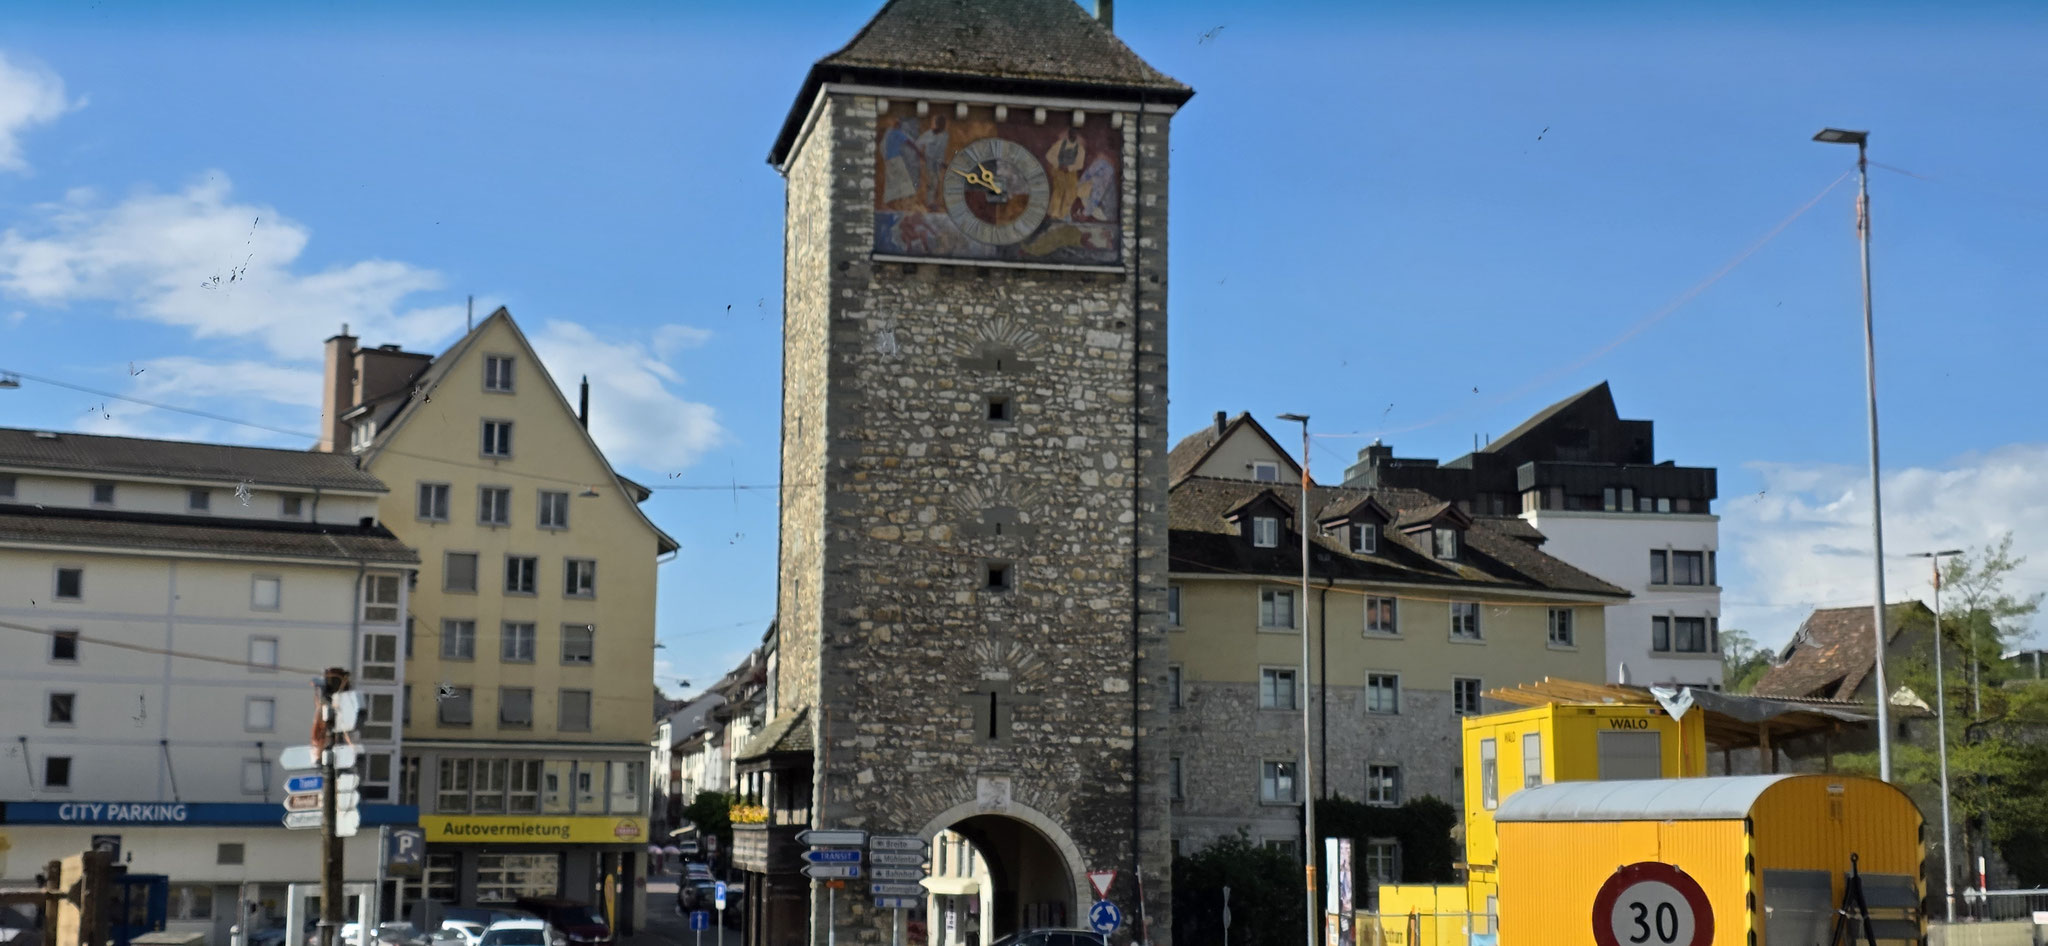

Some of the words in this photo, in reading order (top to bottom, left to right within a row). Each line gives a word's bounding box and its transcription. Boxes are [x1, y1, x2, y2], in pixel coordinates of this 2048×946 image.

[1609, 718, 1649, 730] WALO
[58, 803, 104, 821] CITY
[108, 804, 187, 822] PARKING
[443, 821, 571, 839] Autovermietung
[399, 835, 413, 854] P
[885, 840, 907, 849] Breite
[820, 852, 851, 860] TRANSIT
[885, 870, 916, 878] Bahnhof
[1629, 901, 1679, 944] 30
